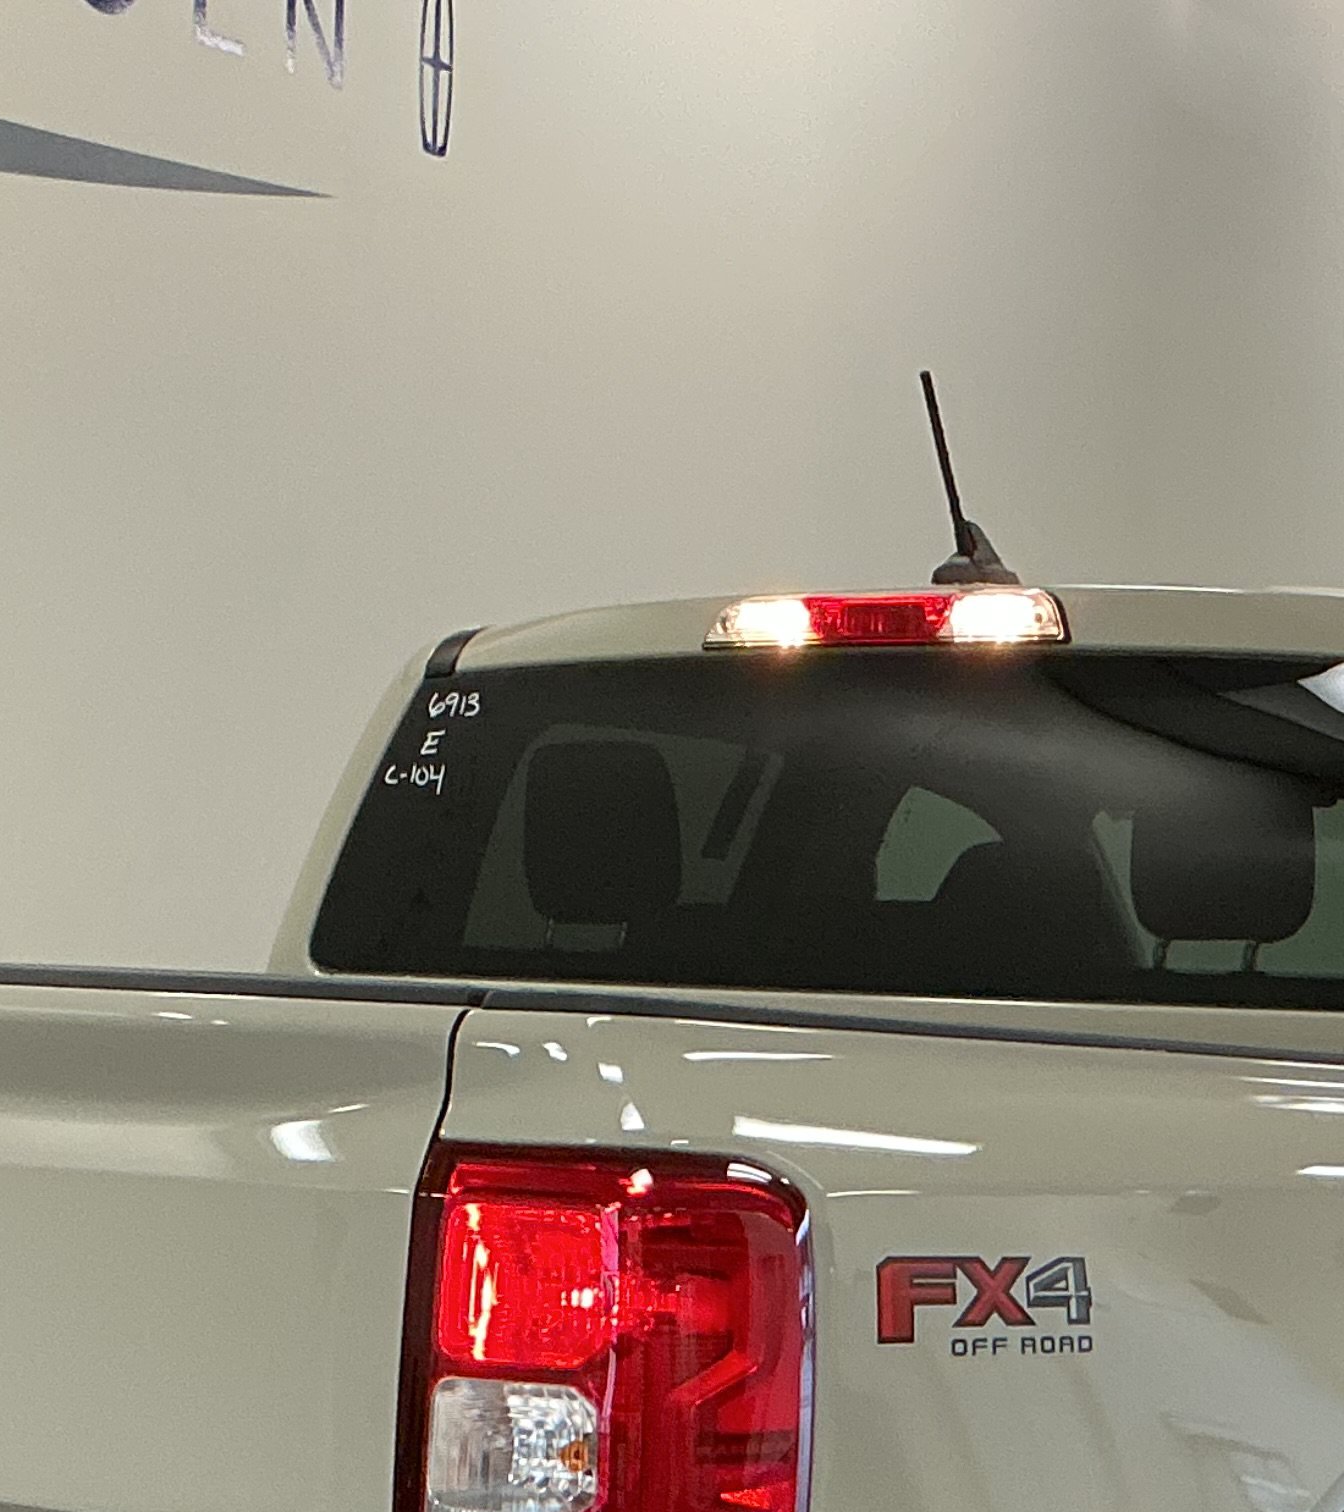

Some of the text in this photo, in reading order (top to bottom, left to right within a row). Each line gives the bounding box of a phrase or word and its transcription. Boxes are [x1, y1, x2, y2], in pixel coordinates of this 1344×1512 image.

[427, 691, 481, 719] 6913
[419, 729, 446, 756] E
[383, 761, 446, 796] C-104
[875, 1255, 1093, 1345] FX4
[950, 1335, 1093, 1357] OFF ROAD
